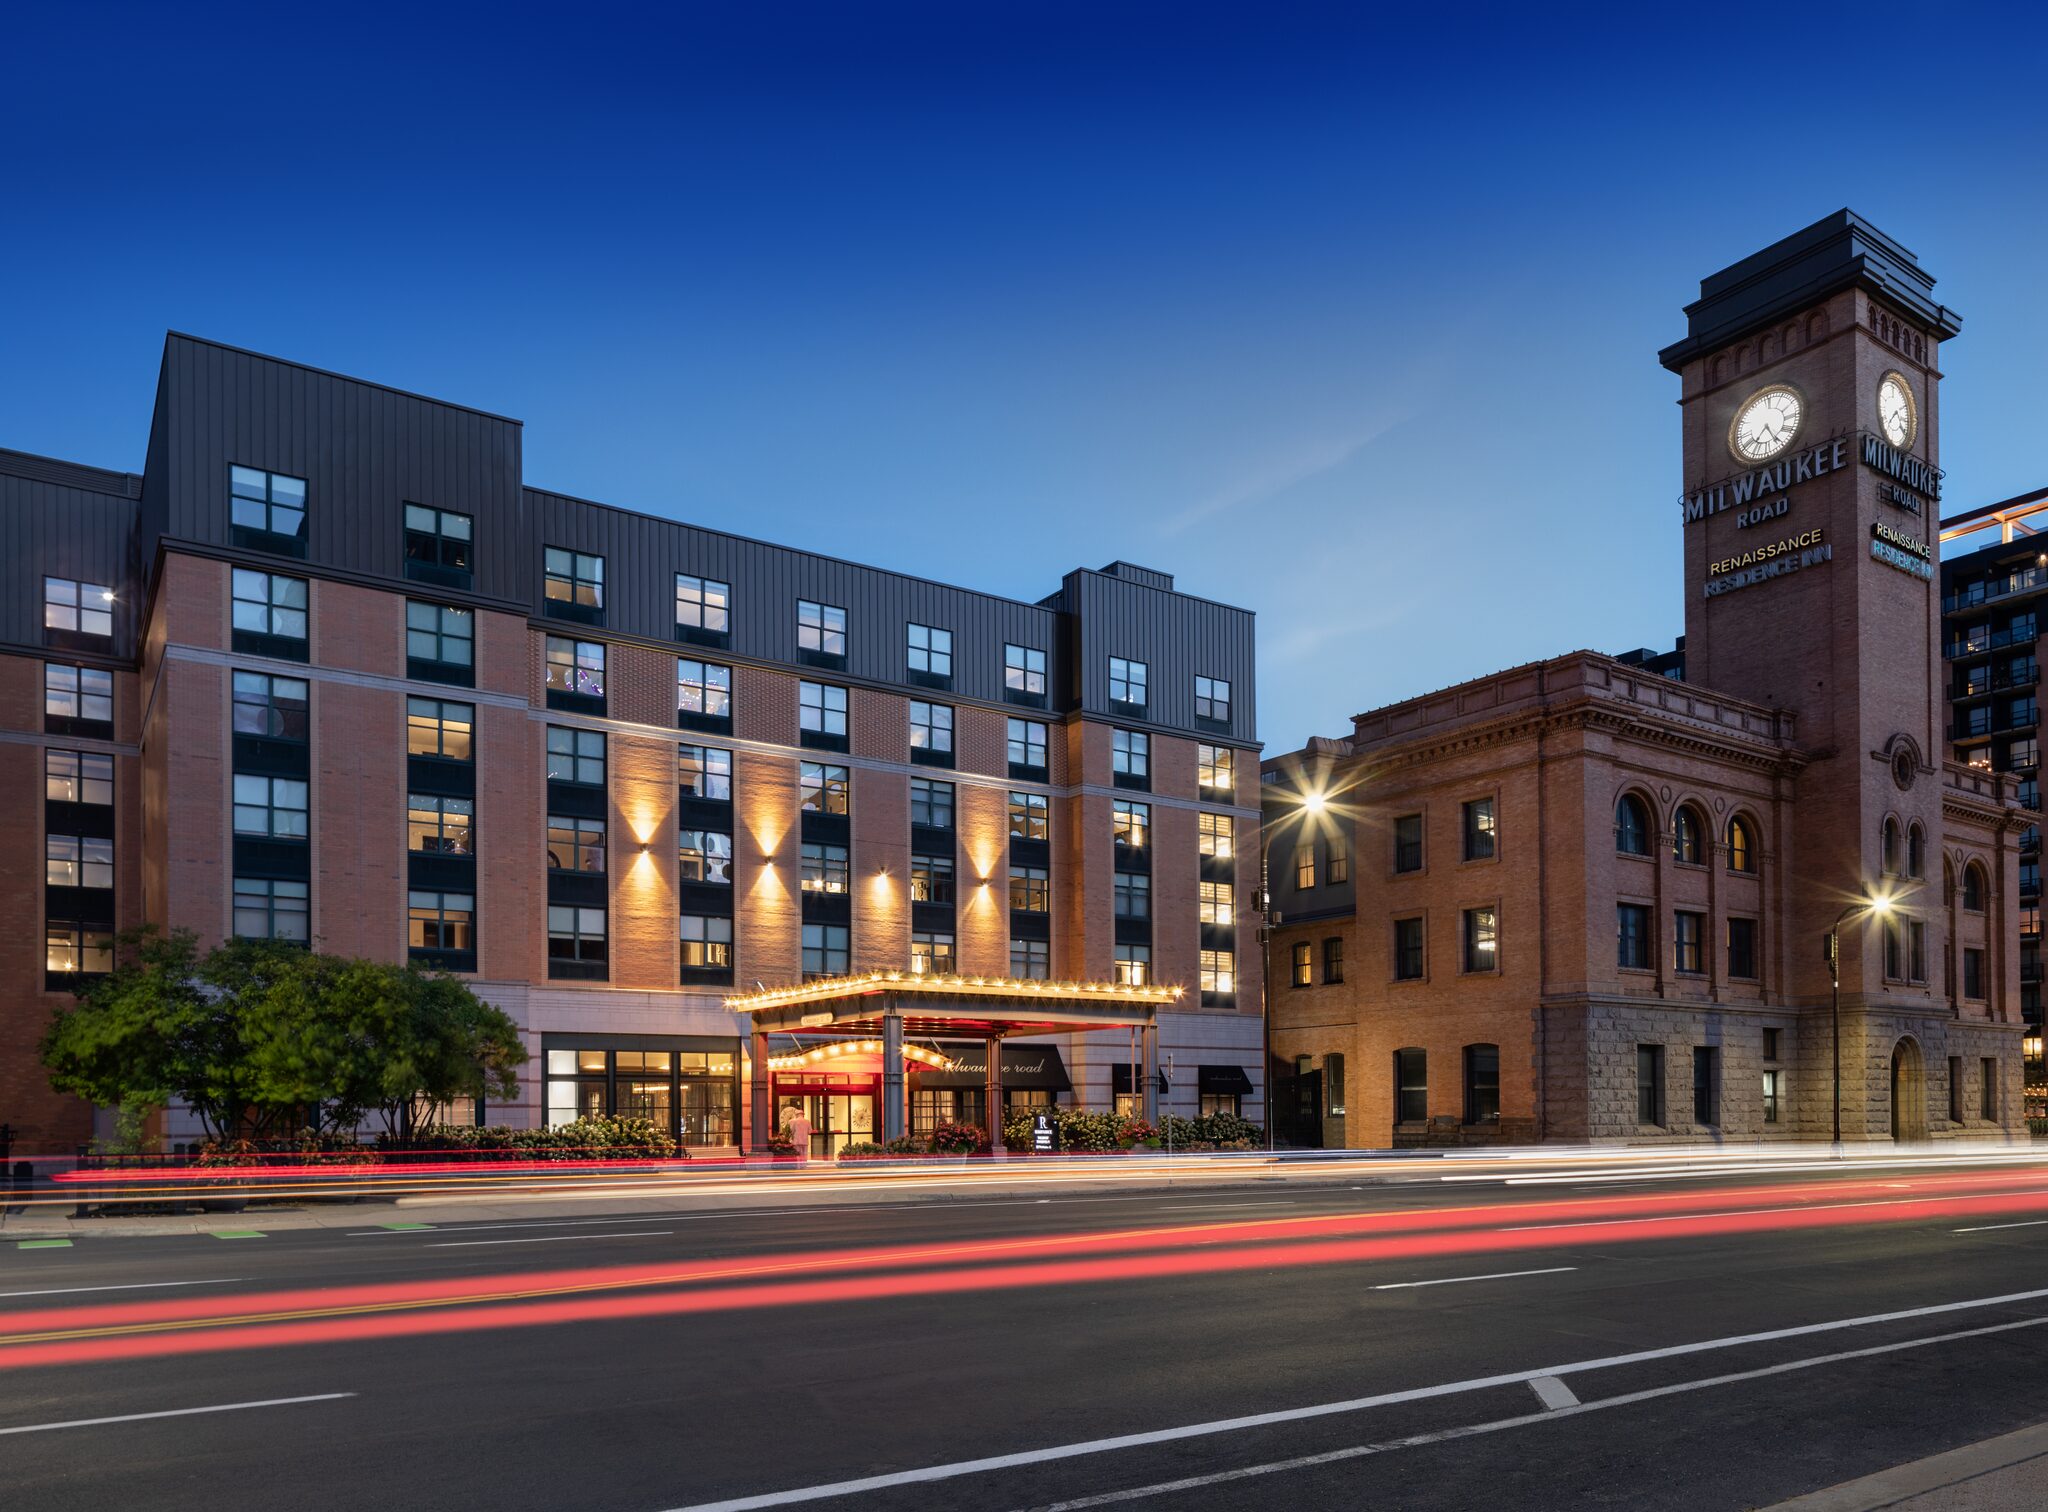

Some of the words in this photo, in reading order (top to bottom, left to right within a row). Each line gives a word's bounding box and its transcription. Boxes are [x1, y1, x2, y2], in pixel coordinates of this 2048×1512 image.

[1684, 437, 1848, 524] MILWAUKEE
[1865, 436, 1942, 501] MILWAUKEE
[1737, 497, 1791, 529] ROAD
[1893, 485, 1919, 511] ROAD
[1710, 528, 1822, 575] RENAISSANCE
[1873, 541, 1920, 575] RESIDENCE
[1876, 522, 1931, 559] RENAISSANCE
[1704, 555, 1799, 598] RESIDENCE
[1801, 544, 1832, 568] INN
[1014, 1058, 1045, 1073] road
[1039, 1115, 1048, 1129] R
